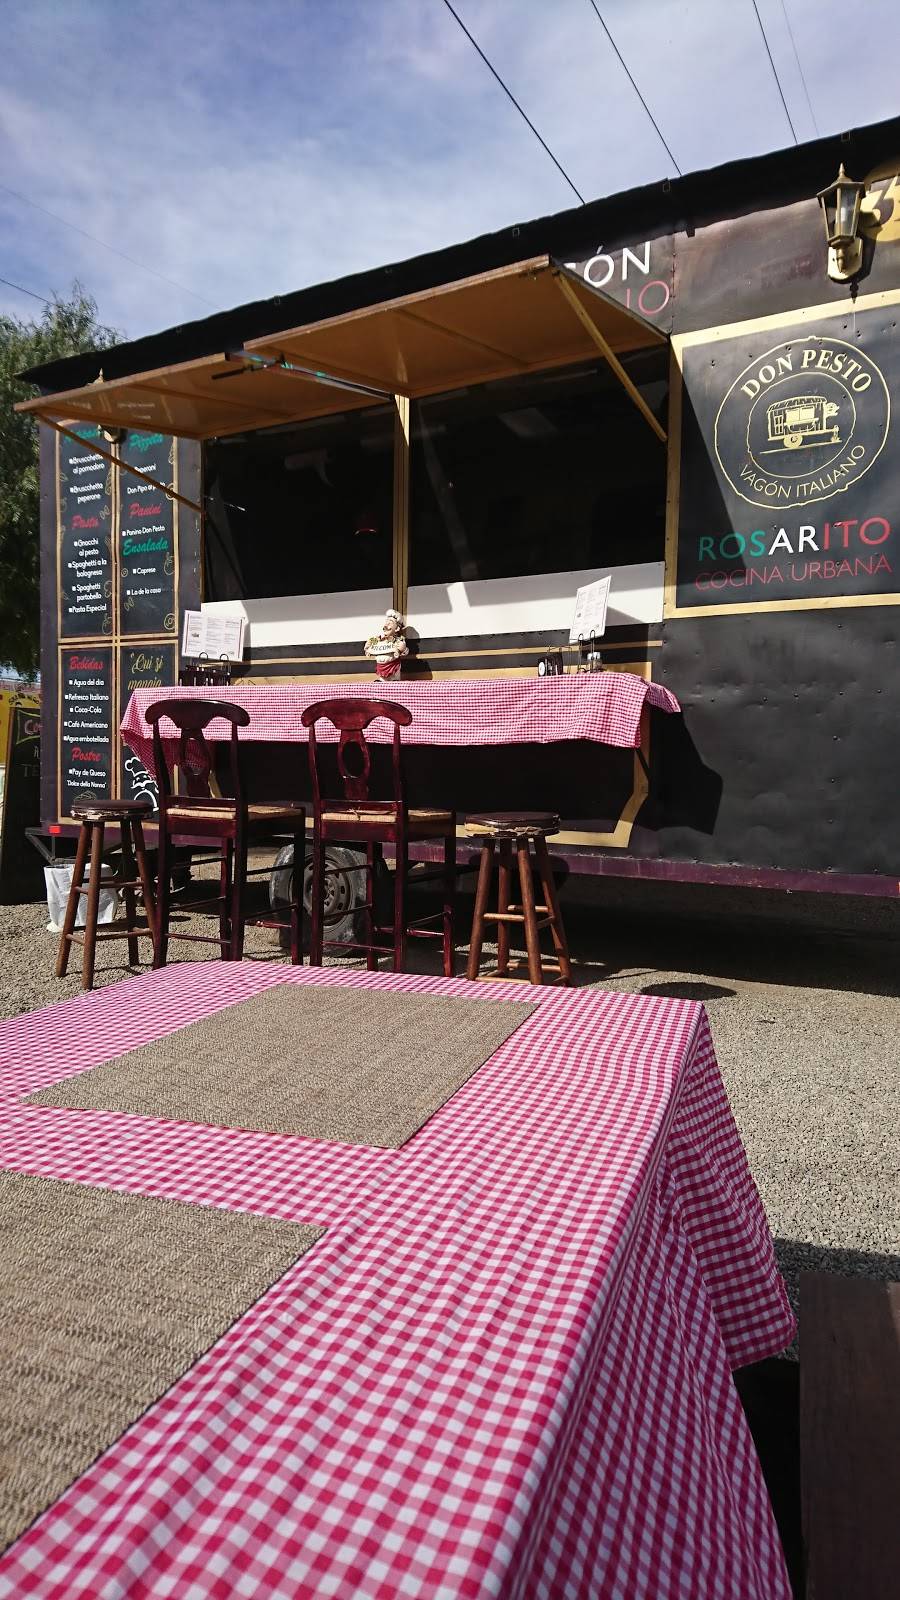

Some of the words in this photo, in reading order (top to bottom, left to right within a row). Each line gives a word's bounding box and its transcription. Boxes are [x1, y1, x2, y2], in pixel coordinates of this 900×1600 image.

[564, 240, 651, 288] ÓN
[740, 353, 795, 400] DON
[801, 349, 873, 393] PESTO
[79, 463, 105, 476] pomodoro
[740, 464, 792, 498] VAGÓN
[796, 445, 866, 497] ITALIANO
[127, 486, 137, 494] Don
[72, 513, 99, 530] Pasta
[77, 538, 99, 547] Gnocchi
[698, 516, 892, 562] ROSARITO
[122, 537, 169, 556] Ensalada
[85, 549, 99, 558] pesto
[72, 559, 97, 571] Spaghetti
[76, 570, 102, 579] bolognesa
[137, 567, 156, 575] Caprese
[695, 564, 784, 591] COCINA
[791, 553, 893, 582] URBANA
[77, 583, 101, 593] Spaghetti
[131, 588, 138, 596] La
[77, 592, 102, 602] portobello
[72, 605, 85, 613] Pasta
[86, 604, 107, 613] Especial
[70, 655, 105, 670] Bebidas
[73, 679, 87, 687] Agua
[90, 693, 109, 701] Italiano
[74, 705, 102, 713] Coca-Cola
[80, 721, 109, 730] Americano
[67, 735, 79, 743] Agua
[79, 735, 110, 743] embotellada
[71, 746, 102, 762] Postre
[72, 768, 82, 777] Pay
[89, 769, 107, 777] Queso
[80, 780, 91, 788] della
